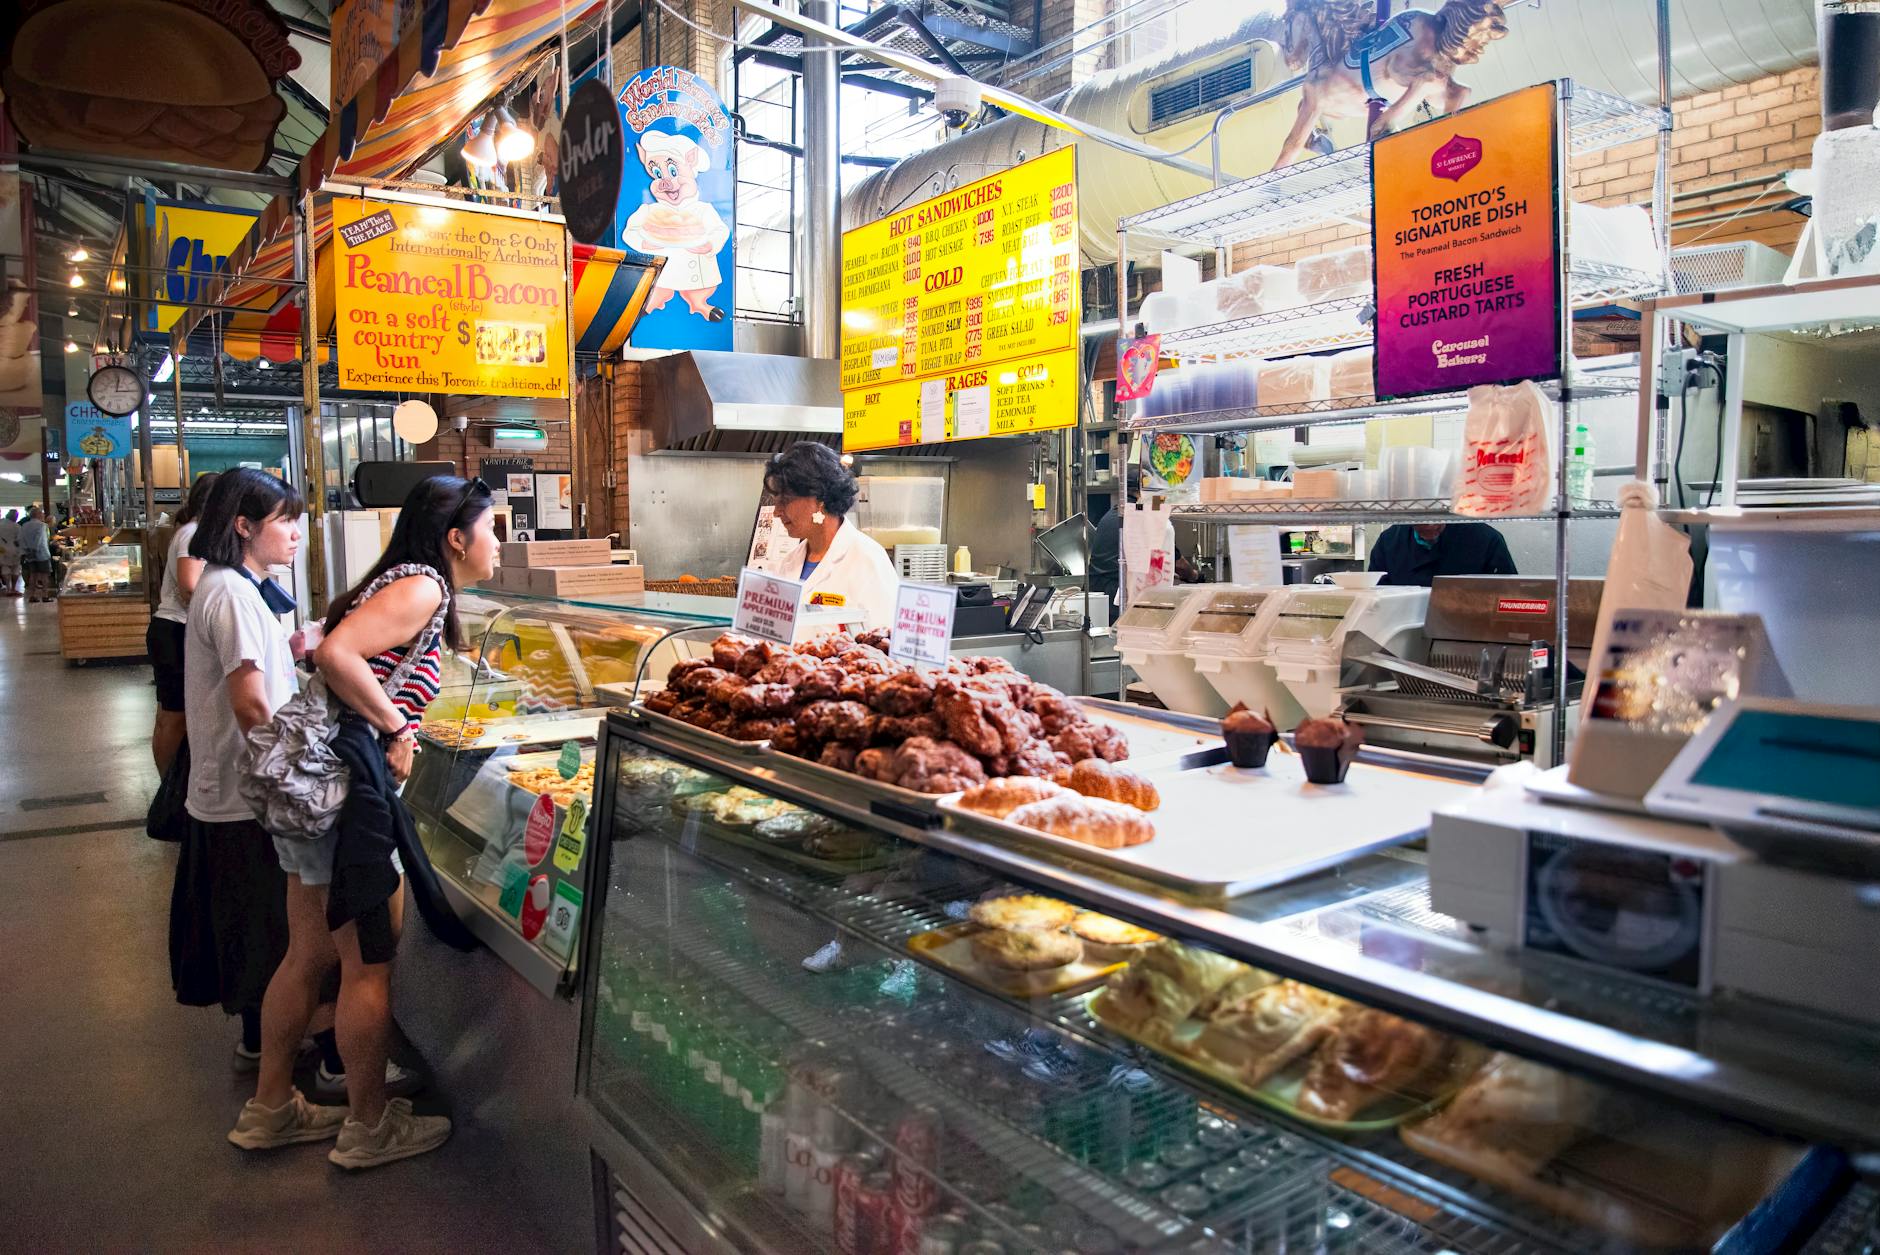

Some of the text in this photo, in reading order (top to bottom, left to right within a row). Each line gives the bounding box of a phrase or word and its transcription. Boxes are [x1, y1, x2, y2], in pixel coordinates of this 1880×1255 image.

[619, 66, 729, 130] World Famous
[626, 90, 722, 146] Sandwiches
[560, 115, 616, 183] Order
[1443, 151, 1477, 167] LAWRENCE
[890, 180, 1002, 238] HOT SANDWICHES
[1017, 193, 1038, 212] STEAK
[1411, 185, 1506, 223] TORONTO'S
[348, 221, 393, 246] THE PLACE!
[942, 218, 968, 237] CHICKEN
[1002, 218, 1022, 236] ROAST
[1025, 212, 1040, 227] BEEF
[1395, 200, 1527, 246] SIGNATURE DISH
[455, 227, 476, 244] the
[479, 230, 506, 247] One
[510, 233, 522, 247] &
[524, 235, 558, 254] Only
[926, 248, 936, 261] HOT
[939, 239, 963, 257] SAUSAGE
[1002, 237, 1020, 255] MEAT
[1400, 224, 1522, 260] The Peameal Bacon Sandwich
[388, 236, 559, 267] Internationally Acclaimed
[845, 254, 868, 271] PEAMEAL
[881, 243, 899, 259] BACON
[344, 254, 560, 308] Peameal Bacon
[845, 271, 866, 287] CHICKEN
[867, 260, 899, 280] PARMIGIANA
[925, 266, 963, 292] COLD
[1434, 262, 1484, 286] FRESH
[845, 289, 857, 301] VEAL
[859, 279, 891, 298] PARMIGIANA
[1408, 275, 1514, 309] PORTUGUESE
[349, 303, 451, 332] on a soft
[449, 299, 483, 315] (style)
[922, 303, 947, 321] CHICKEN
[949, 300, 961, 314] PITA
[1400, 291, 1525, 328] CUSTARD TARTS
[921, 322, 944, 338] SMOKED
[987, 324, 1008, 340] GREEK
[1011, 319, 1034, 335] SALAD
[353, 329, 445, 355] country
[921, 340, 936, 354] TUNA
[940, 337, 952, 351] PITA
[1432, 335, 1490, 355] Carousel
[375, 344, 421, 370] bun
[844, 356, 870, 371] EGGPLANT
[921, 356, 941, 371] VEGGIE
[944, 352, 962, 366] WRAP
[1437, 353, 1487, 368] Bakery
[346, 368, 414, 386] Experience
[415, 369, 440, 386] this
[441, 371, 488, 388] Toronto
[844, 374, 856, 386] HAM
[863, 368, 881, 382] CHEESE
[1017, 363, 1043, 378] COLD
[865, 393, 880, 405] HOT
[996, 385, 1015, 396] SOFT
[1017, 381, 1045, 394] DRINKS
[997, 395, 1031, 407] ICED TEA
[846, 410, 866, 420] COFFEE
[996, 405, 1037, 419] LEMONADE
[847, 421, 857, 429] TEA
[996, 419, 1015, 429] MILK
[742, 602, 763, 614] APPLE
[765, 608, 793, 622] FRITTER
[745, 590, 794, 613] PREMIUM
[1500, 602, 1547, 610] THUNDERBIRD
[899, 607, 945, 625] PREMIUM
[897, 622, 915, 632] APPLE
